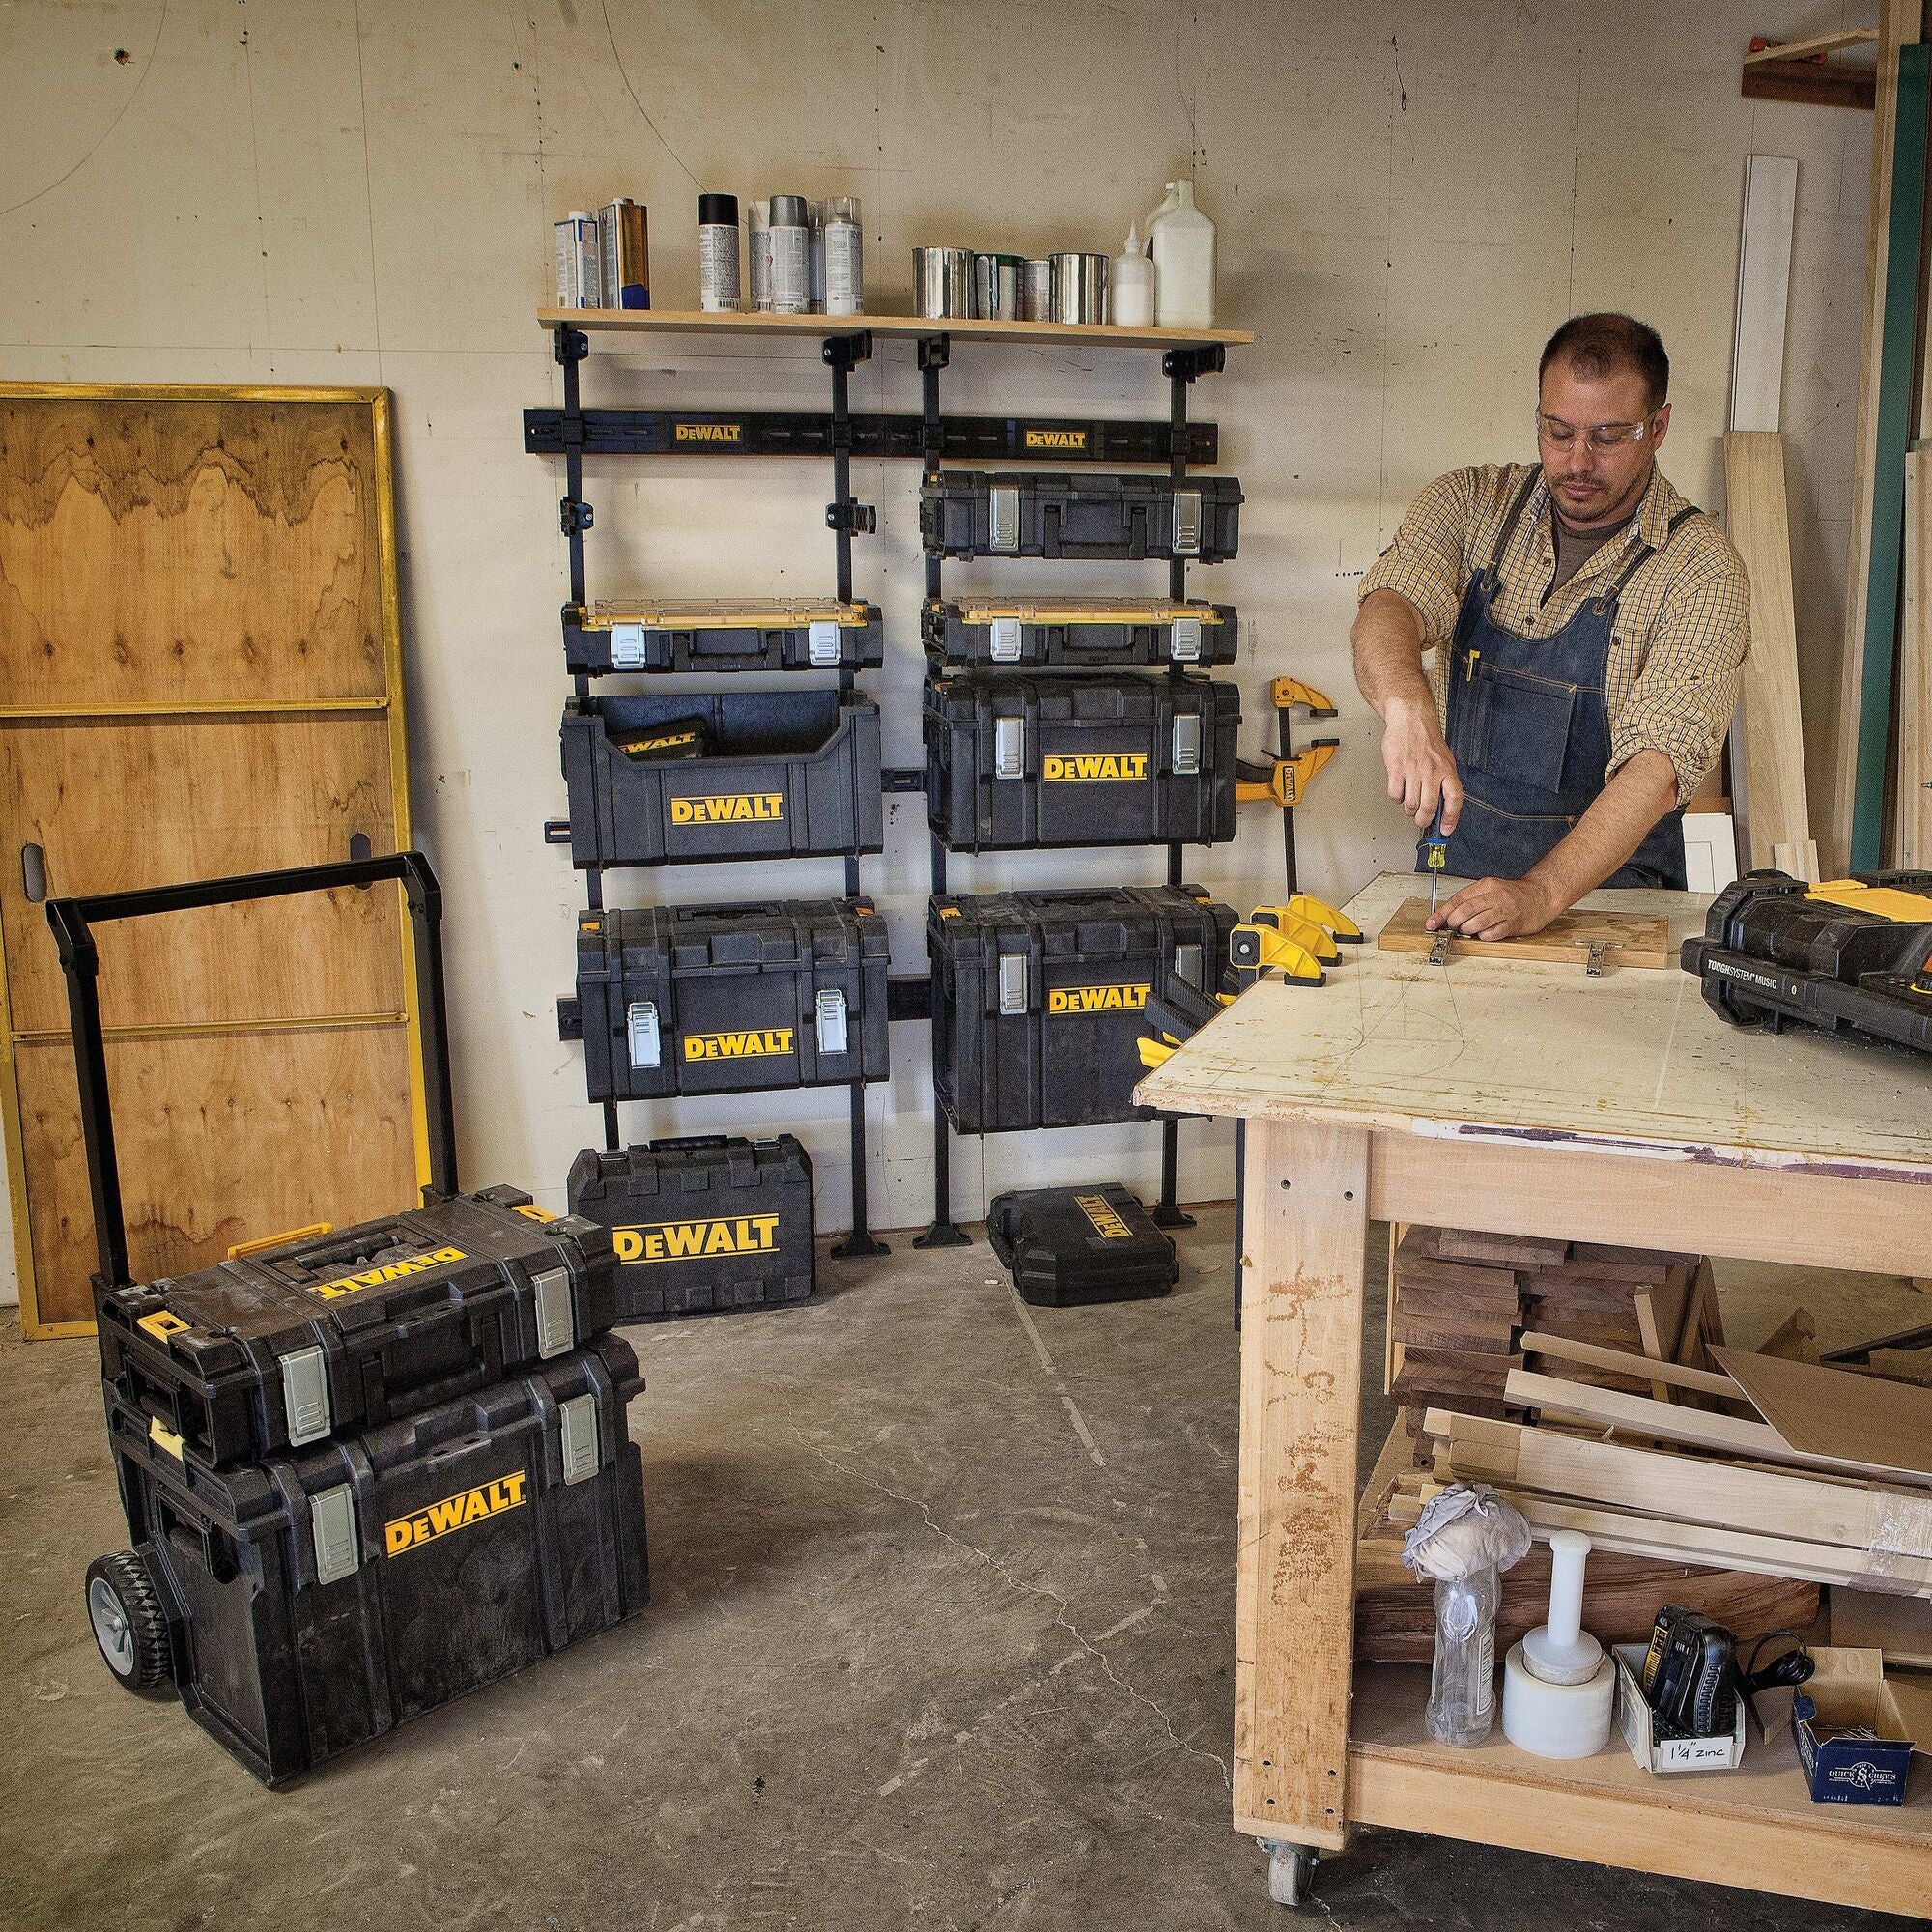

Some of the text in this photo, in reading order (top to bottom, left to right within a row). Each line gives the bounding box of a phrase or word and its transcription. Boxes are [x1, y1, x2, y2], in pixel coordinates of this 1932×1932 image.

[618, 732, 695, 753] WALT
[1754, 974, 1776, 989] MUSIC
[1695, 1746, 1725, 1758] zinc
[1829, 1769, 1855, 1778] QUICK
